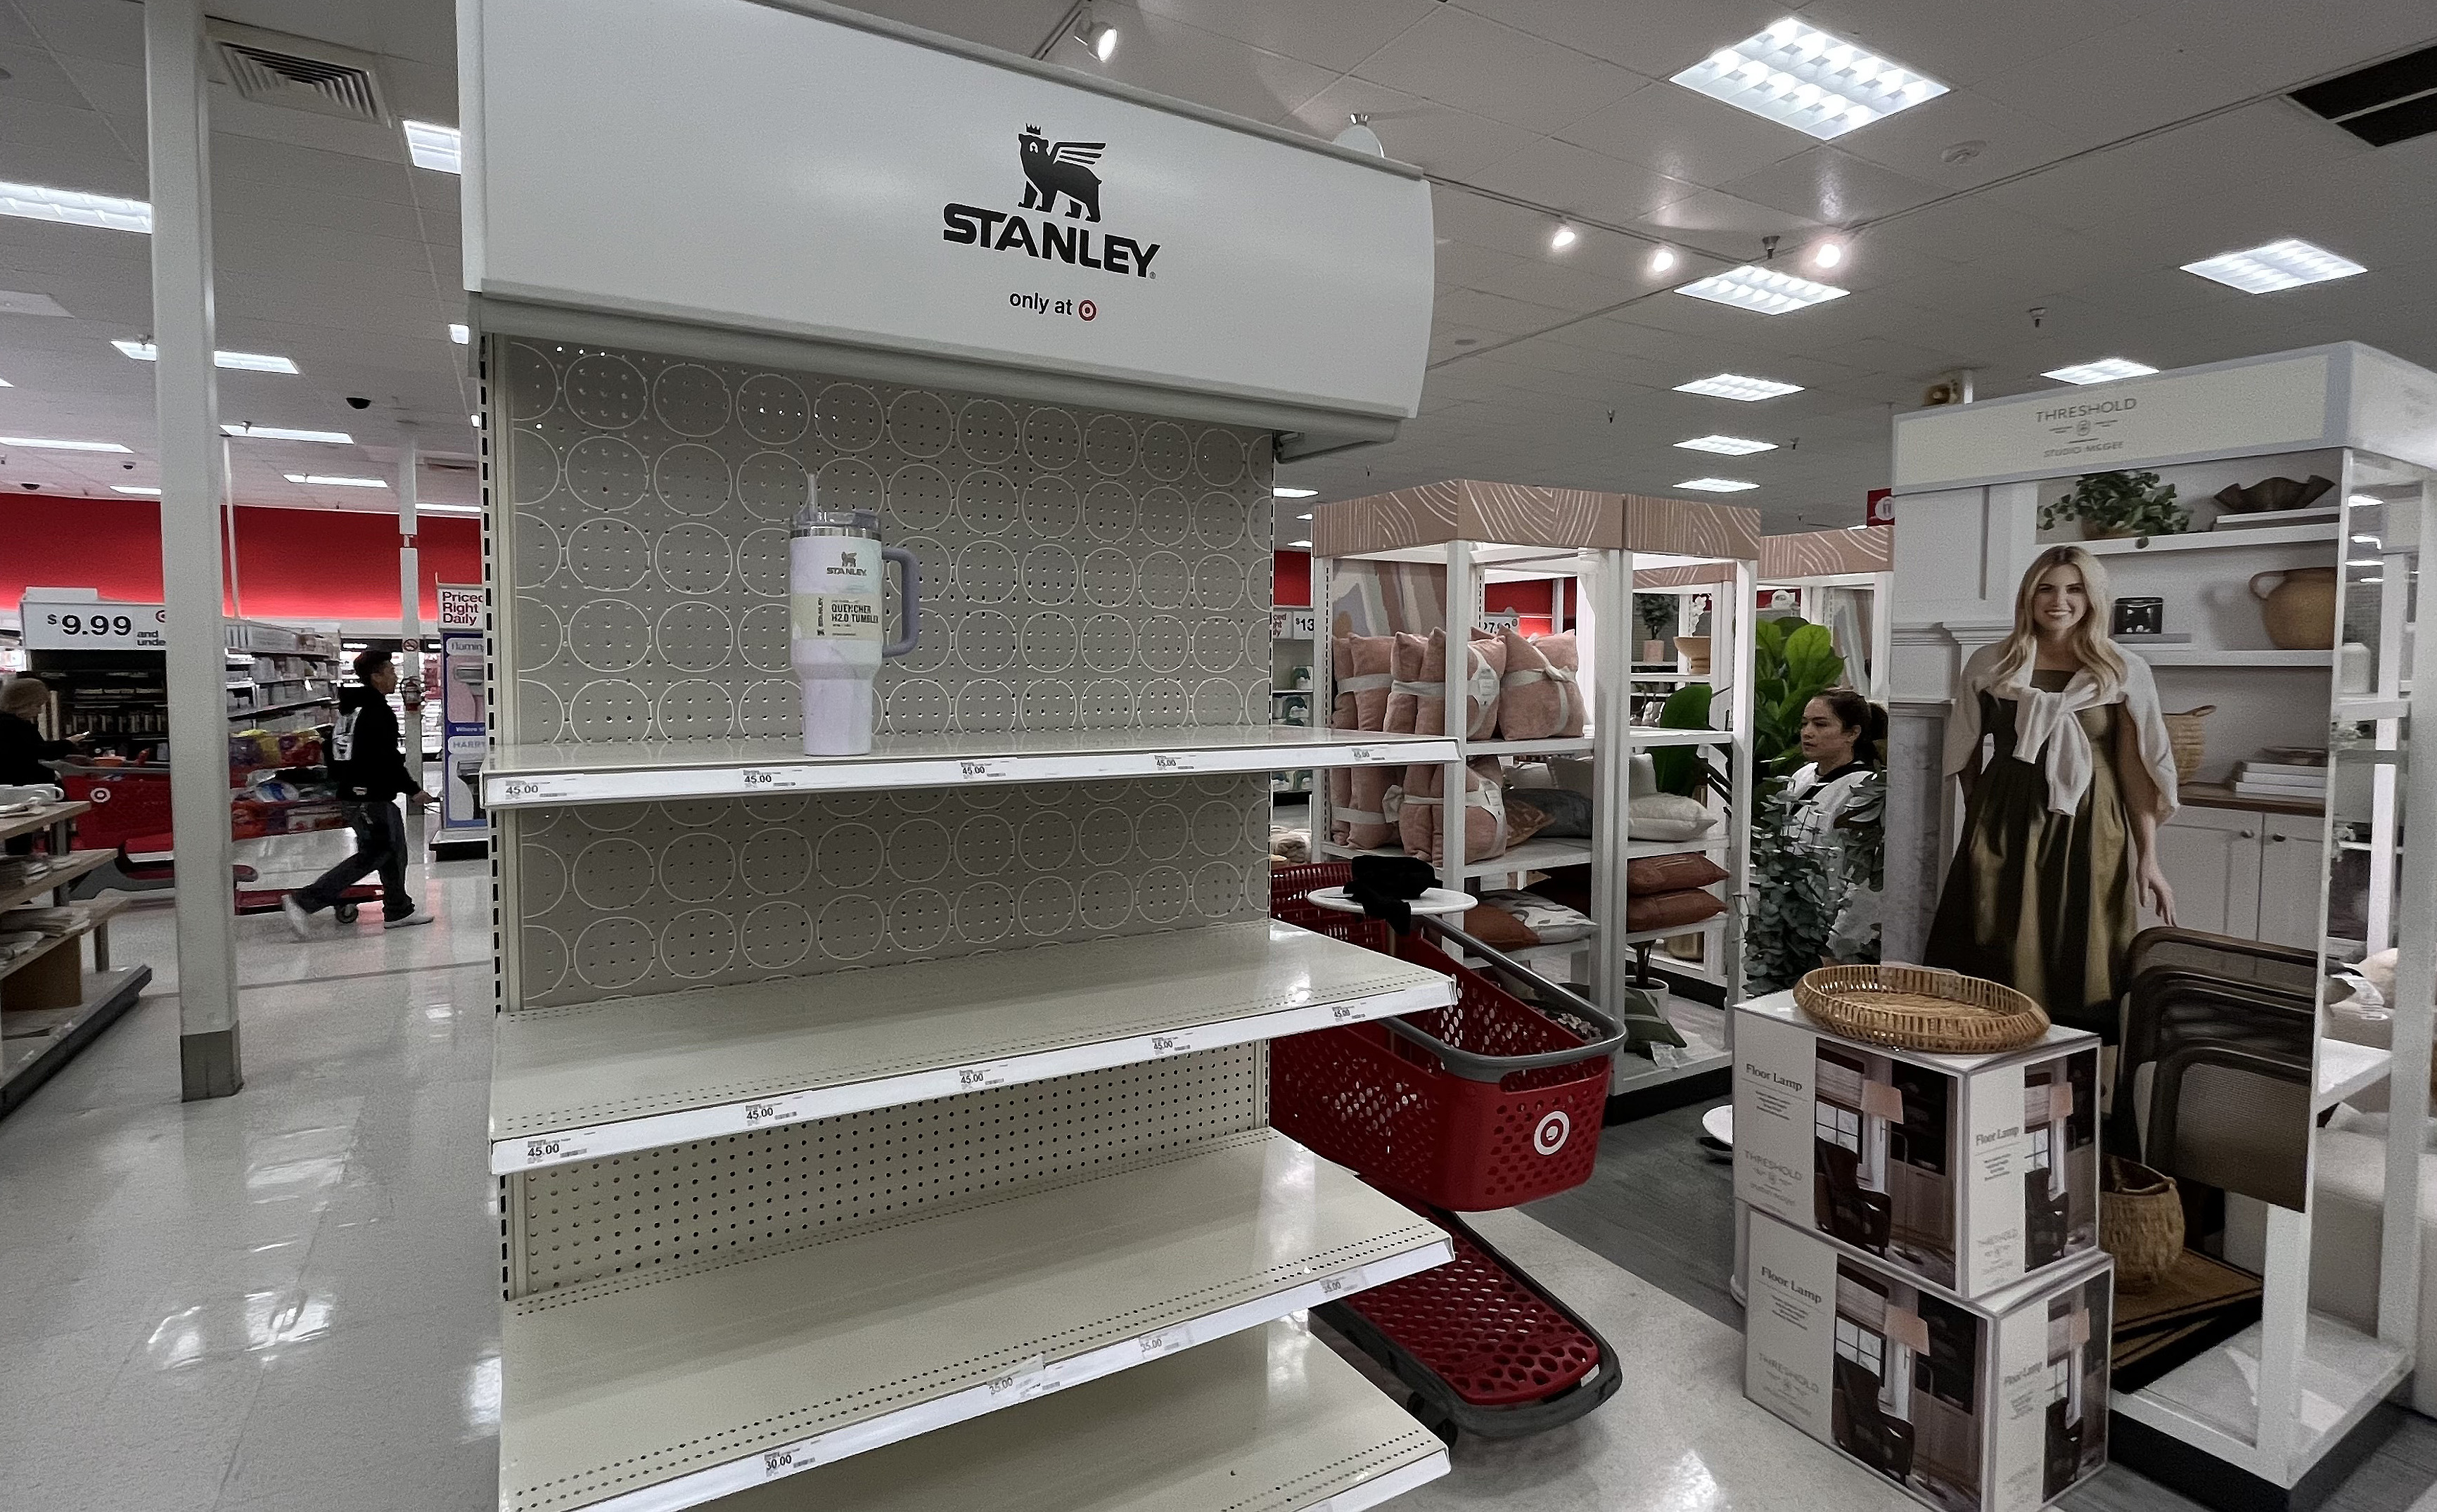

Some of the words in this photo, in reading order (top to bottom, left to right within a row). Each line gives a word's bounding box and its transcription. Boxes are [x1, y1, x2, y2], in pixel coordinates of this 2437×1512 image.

[943, 203, 1161, 278] STANLEY
[1009, 293, 1049, 314] only
[1054, 298, 1073, 315] at
[2035, 397, 2137, 422] THRESHOLD
[826, 567, 867, 577] STANLEY
[442, 603, 479, 615] Right
[831, 603, 871, 614] QUENCHER
[47, 613, 132, 636] $9.99
[443, 613, 478, 626] Daily
[962, 766, 985, 774] 45.00
[744, 774, 772, 783] 45.00
[505, 785, 539, 794] 45.00
[1153, 1040, 1173, 1051] 45.00
[961, 1073, 984, 1084] 45.00
[1746, 1063, 1771, 1079] Floor
[1773, 1072, 1803, 1091] Lamp
[746, 1107, 774, 1120] 45.00
[527, 1143, 560, 1157] 45.00
[1762, 1266, 1789, 1288] Floor
[1791, 1279, 1822, 1304] Lamp
[766, 1454, 792, 1471] 30.00
